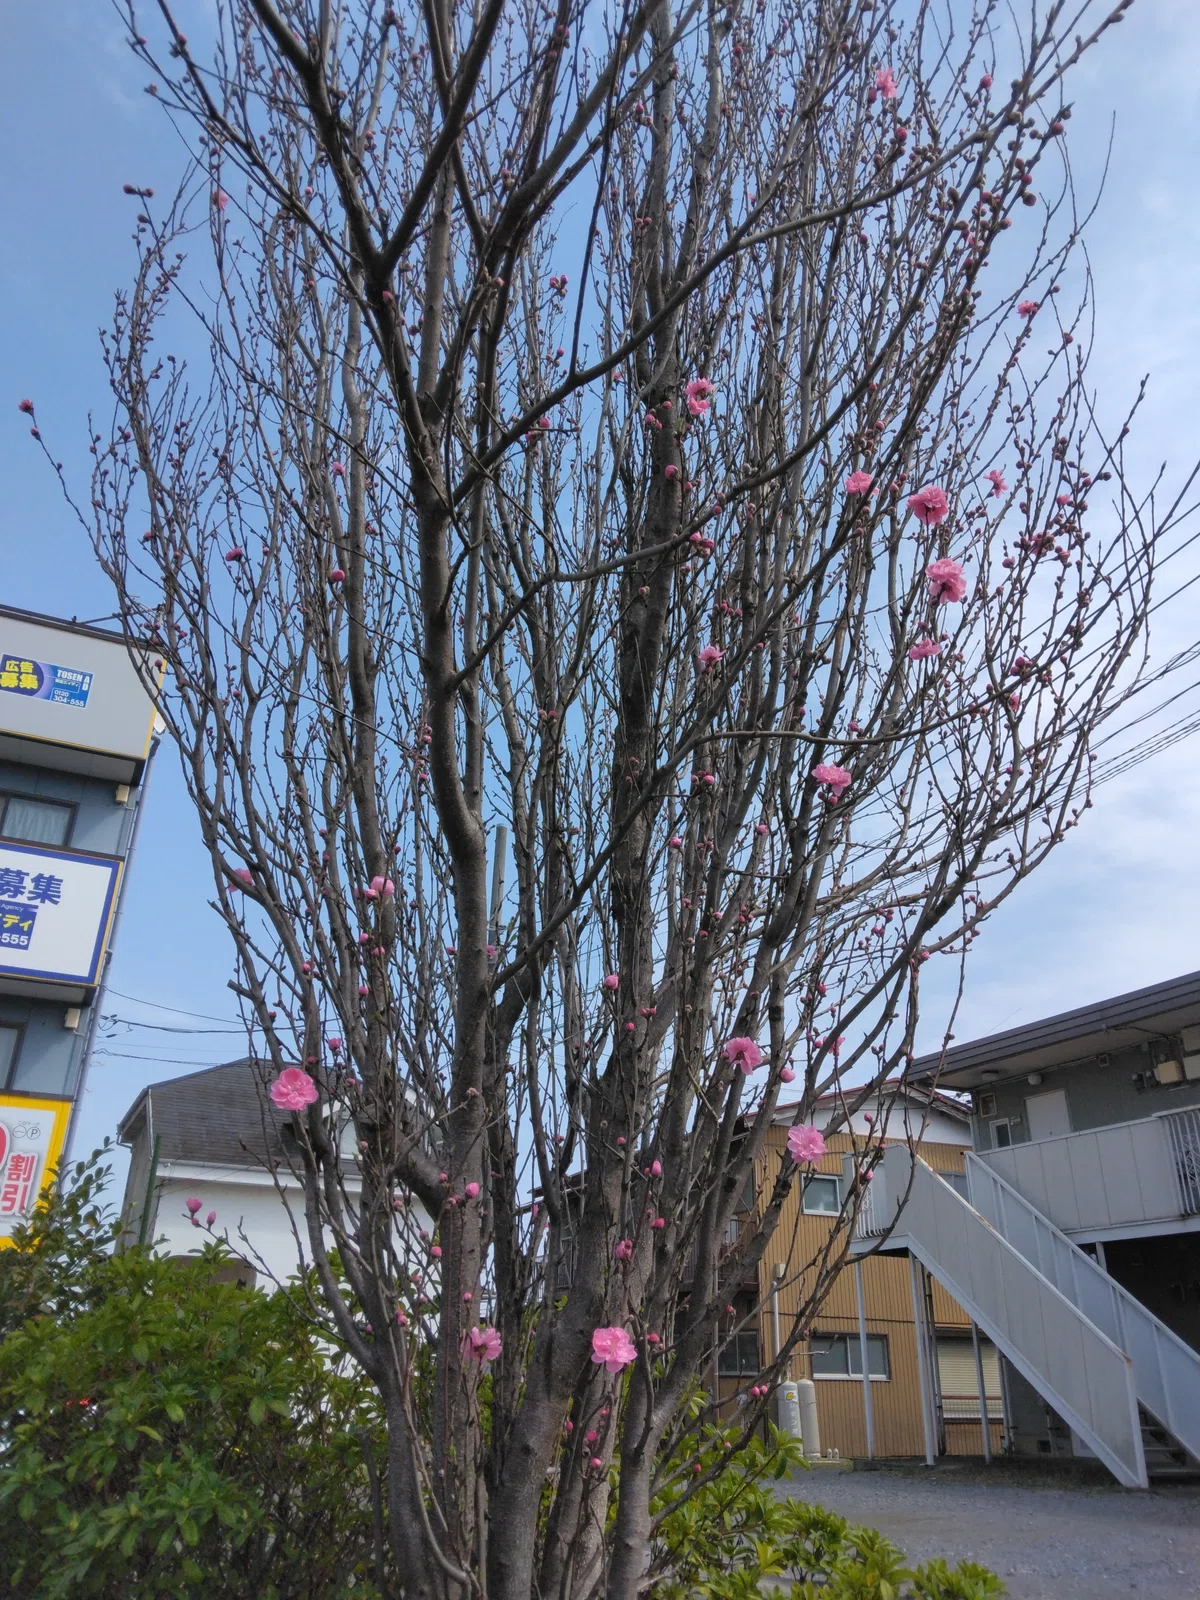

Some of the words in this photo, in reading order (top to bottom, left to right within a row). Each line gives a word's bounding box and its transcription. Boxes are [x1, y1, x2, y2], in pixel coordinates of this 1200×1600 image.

[5, 660, 34, 673] 広告
[0, 671, 38, 689] 募集
[57, 669, 82, 681] TOSEN
[54, 689, 70, 697] 0120
[53, 695, 84, 706] 304-555
[0, 867, 63, 905] 募集
[1, 903, 24, 912] Agency
[0, 913, 33, 932] ディ
[0, 932, 28, 945] 555
[1, 1154, 36, 1213] 割引
